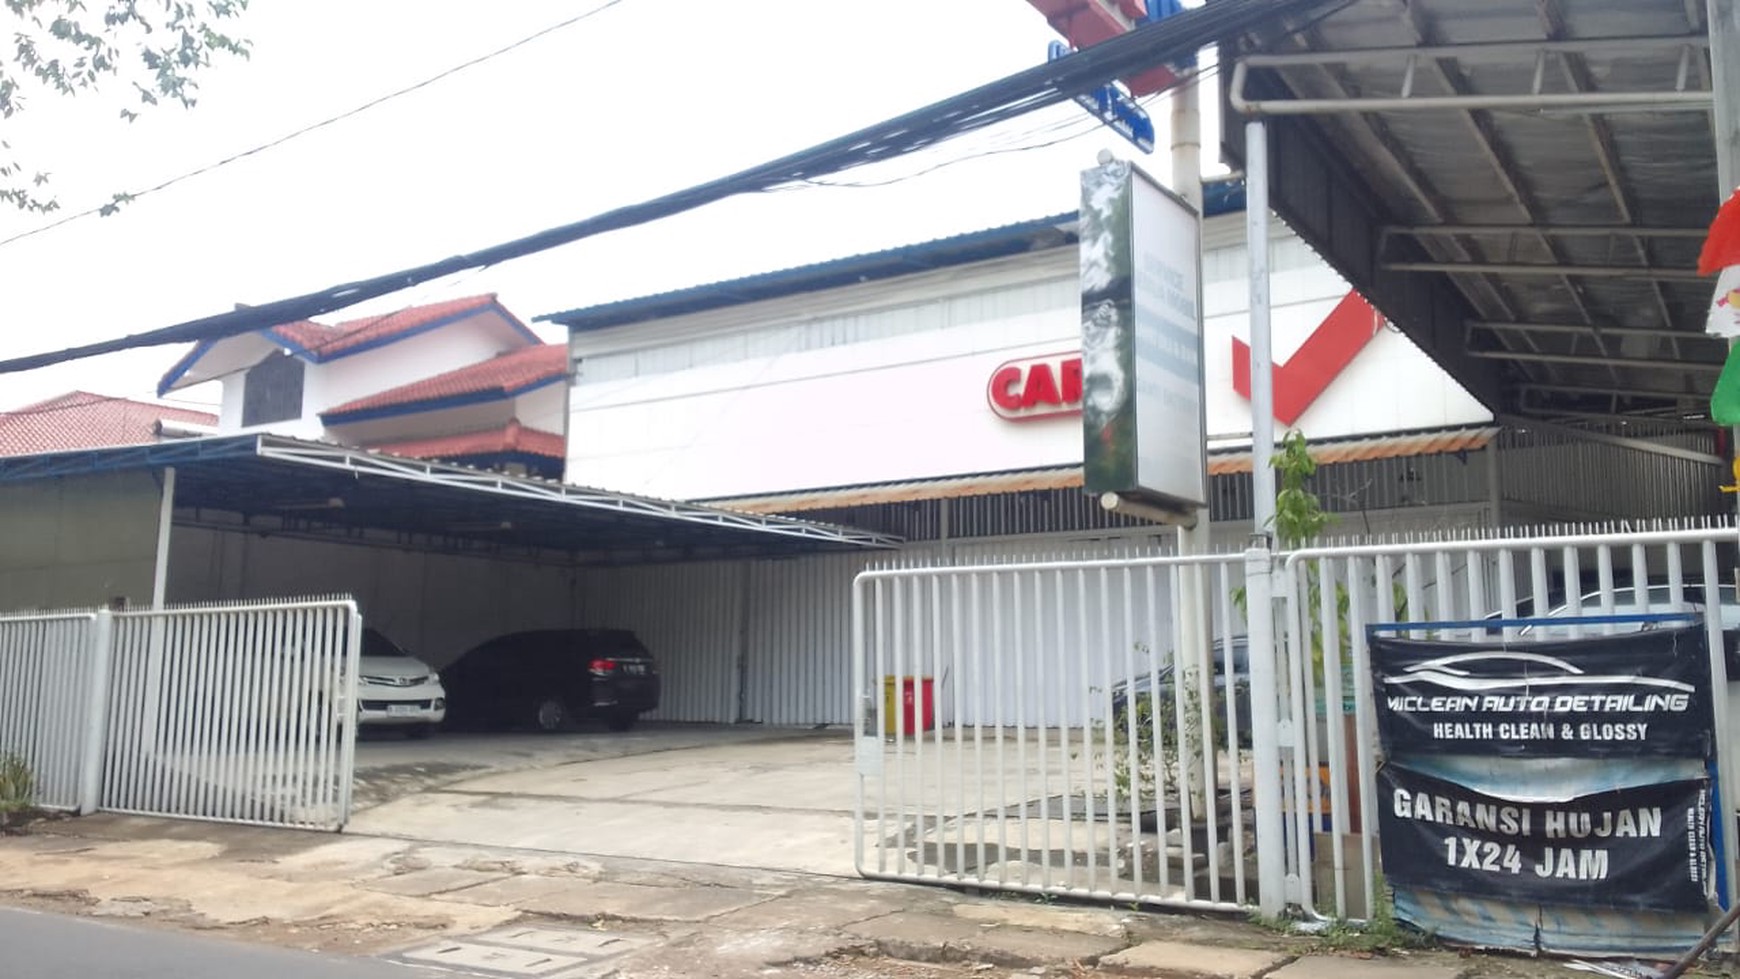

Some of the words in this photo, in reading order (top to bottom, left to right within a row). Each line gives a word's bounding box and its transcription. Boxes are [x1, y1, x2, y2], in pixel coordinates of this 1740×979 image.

[1481, 696, 1550, 712] AUTO
[1554, 694, 1690, 712] DETAILING
[1433, 723, 1493, 739] HEALTH
[1499, 723, 1555, 740] CLEAN
[1561, 723, 1574, 739] &
[1580, 723, 1648, 740] GLOSSY
[1394, 788, 1531, 836] GARANSI
[1545, 807, 1662, 838] HUJAN
[1444, 836, 1521, 874] 1X24
[1535, 847, 1609, 880] JAM
